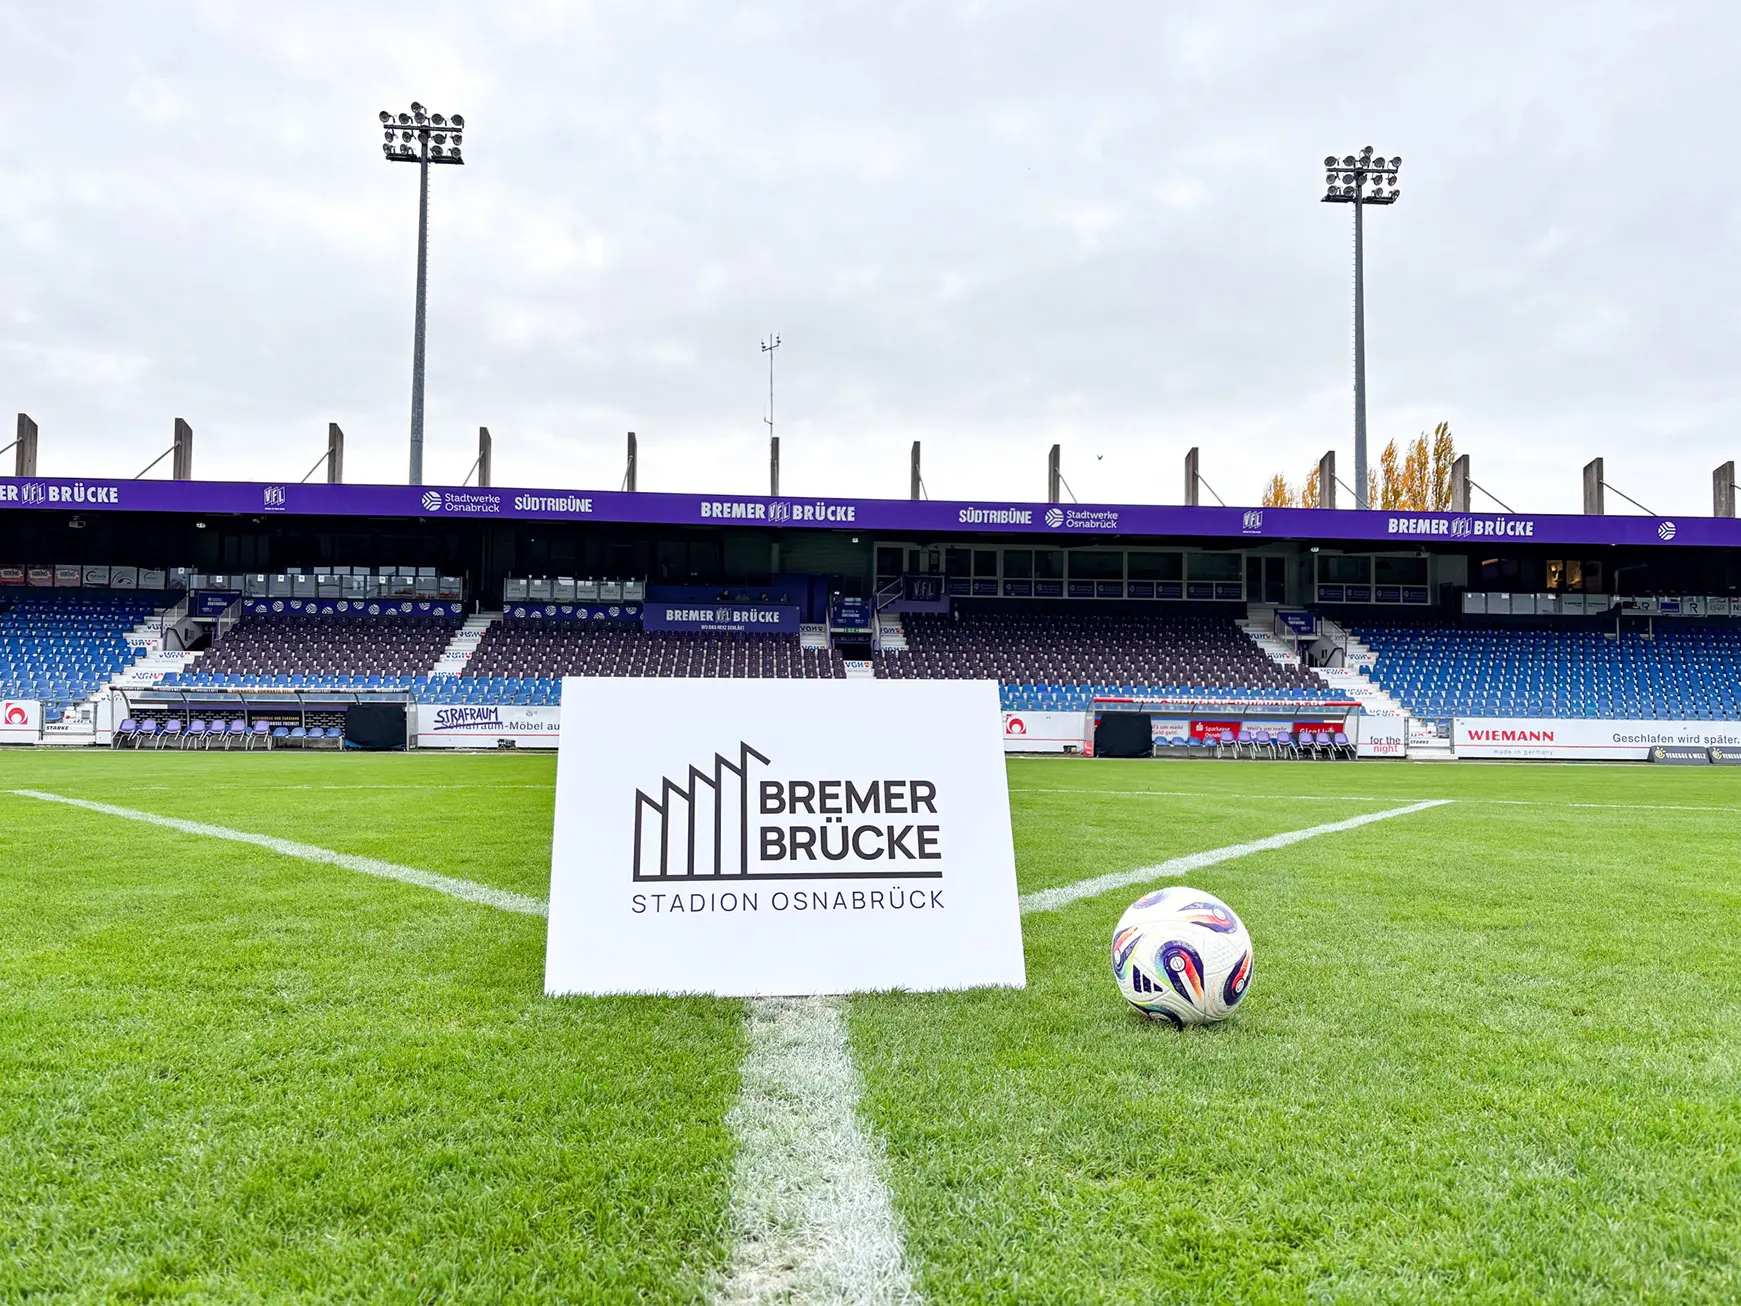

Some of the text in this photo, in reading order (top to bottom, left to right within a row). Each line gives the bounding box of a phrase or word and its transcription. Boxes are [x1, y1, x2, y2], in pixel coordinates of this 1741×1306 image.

[48, 482, 118, 503] BRÜCKE
[445, 492, 501, 503] Stadtwerke
[445, 502, 500, 512] Osnabrück
[514, 494, 592, 512] SÜDTRIBÜNE
[701, 501, 766, 518] BREMER
[793, 502, 855, 521] BRÜCKE
[958, 507, 1032, 524] SÜDTRIBÜNE
[1066, 510, 1119, 520] Stadtwerke
[1066, 519, 1117, 529] Osnabrück
[1388, 518, 1449, 535] BREMER
[1474, 517, 1534, 536] BRÜCKE
[666, 609, 713, 621] BREMER
[733, 608, 779, 623] BRÜCKE
[434, 706, 499, 723] STRAFRAUM
[1370, 736, 1401, 745] for the
[1467, 730, 1554, 741] WIEMANN
[1612, 733, 1740, 746] Geschlafen wird später.
[1373, 744, 1398, 754] night
[759, 779, 938, 815] BREMER
[760, 816, 943, 862] BRÜCKE
[631, 886, 945, 914] STADION OSNABRÜCK
